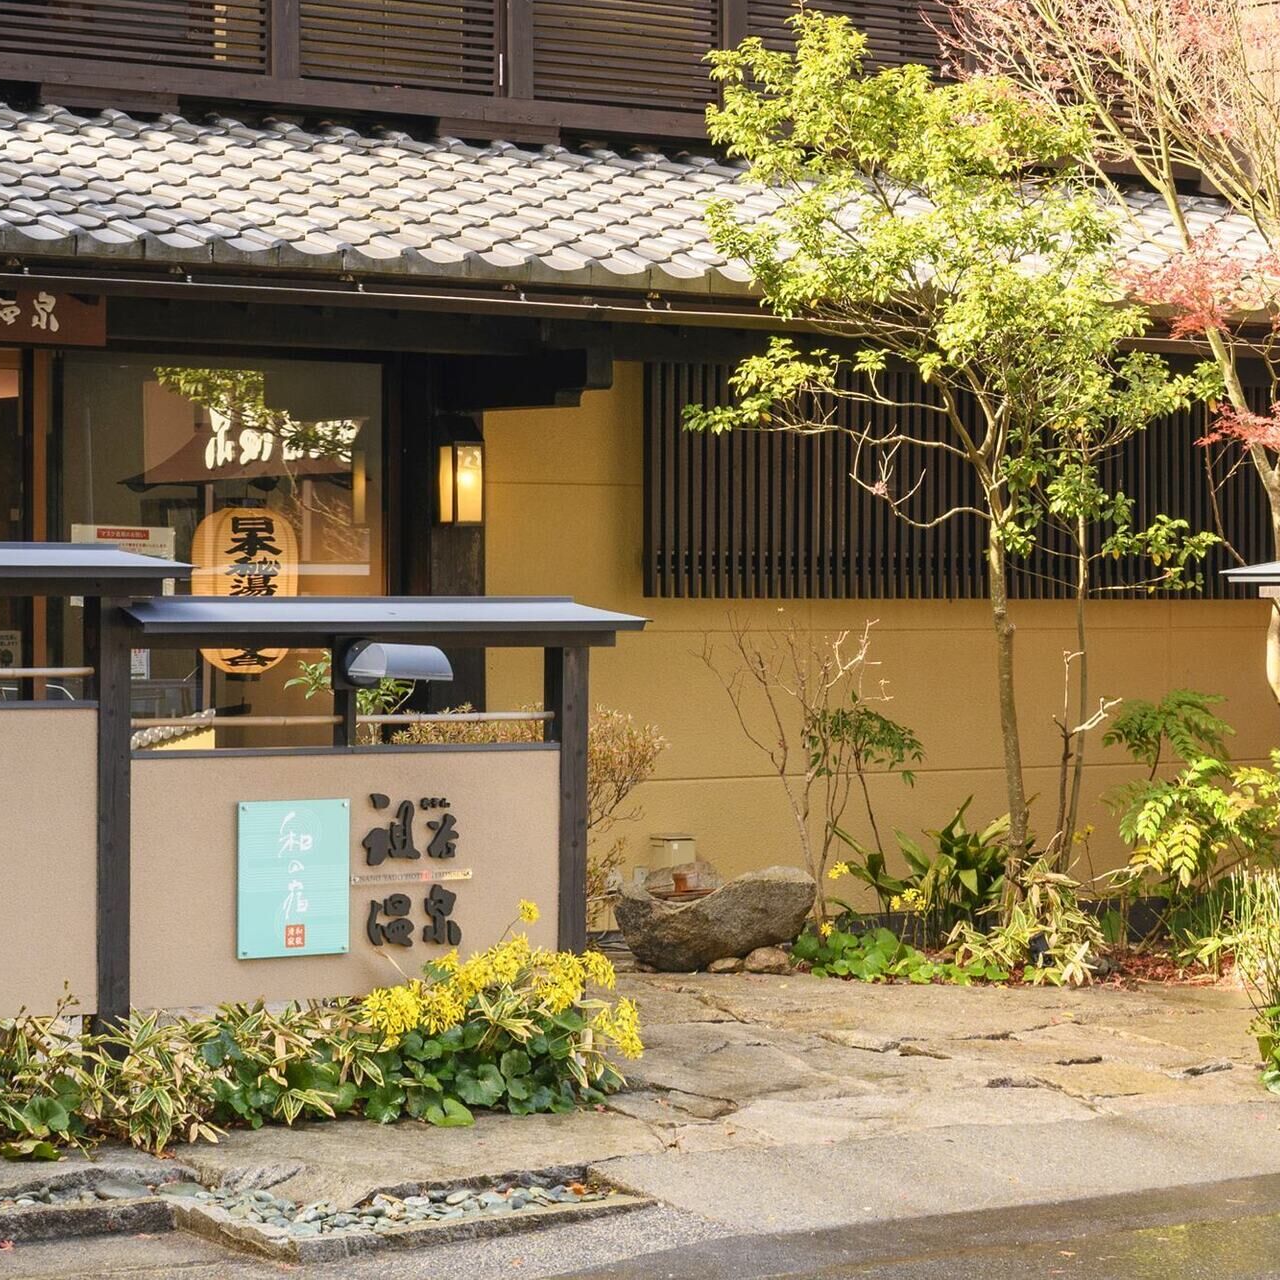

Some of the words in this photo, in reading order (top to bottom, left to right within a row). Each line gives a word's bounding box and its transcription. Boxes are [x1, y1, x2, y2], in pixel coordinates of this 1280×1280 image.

[224, 516, 283, 667] 日本秘湯会
